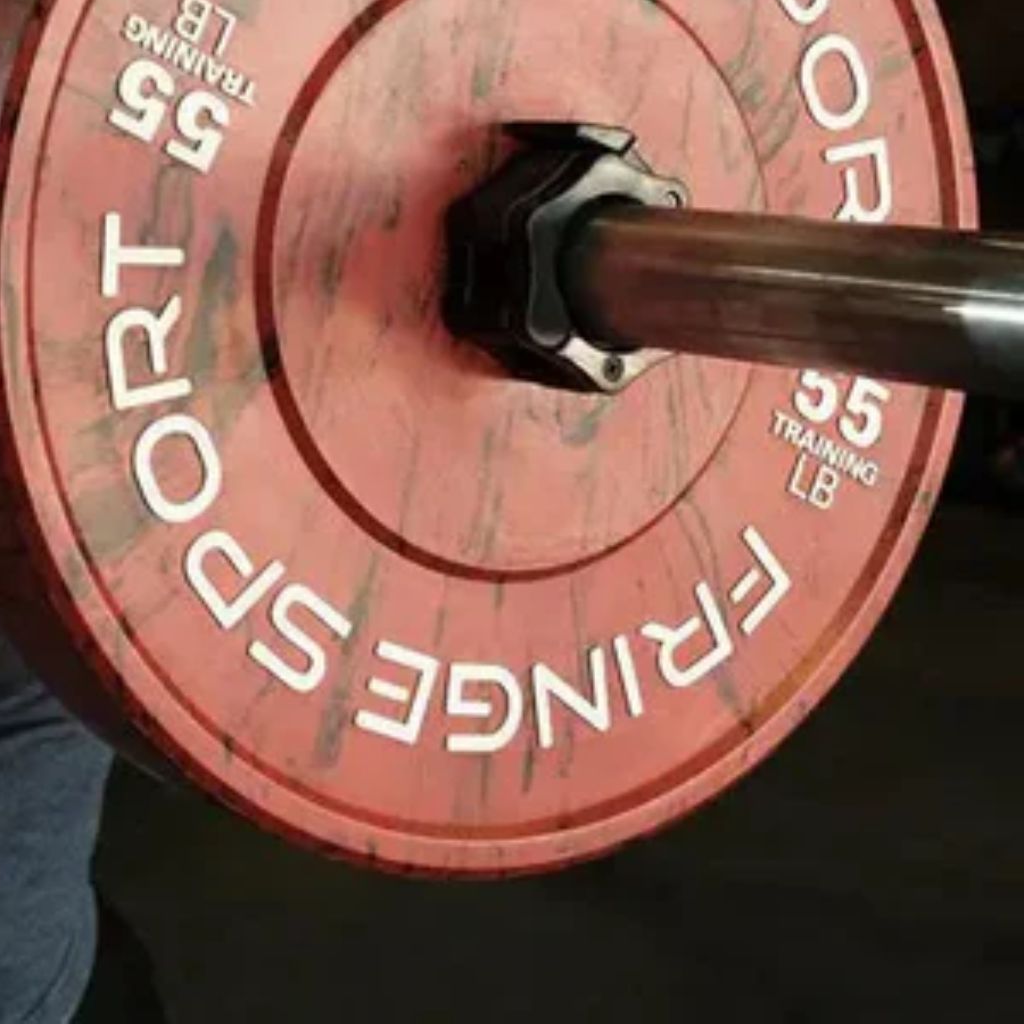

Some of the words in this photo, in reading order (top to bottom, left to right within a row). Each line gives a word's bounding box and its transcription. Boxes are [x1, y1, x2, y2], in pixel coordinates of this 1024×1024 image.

[125, 14, 257, 106] TRAINING
[109, 59, 231, 174] 55
[772, 409, 879, 487] TRAINING
[794, 369, 892, 449] 55
[100, 212, 353, 693] SPORT
[355, 525, 792, 753] FRINGE
[788, 452, 841, 510] LB
